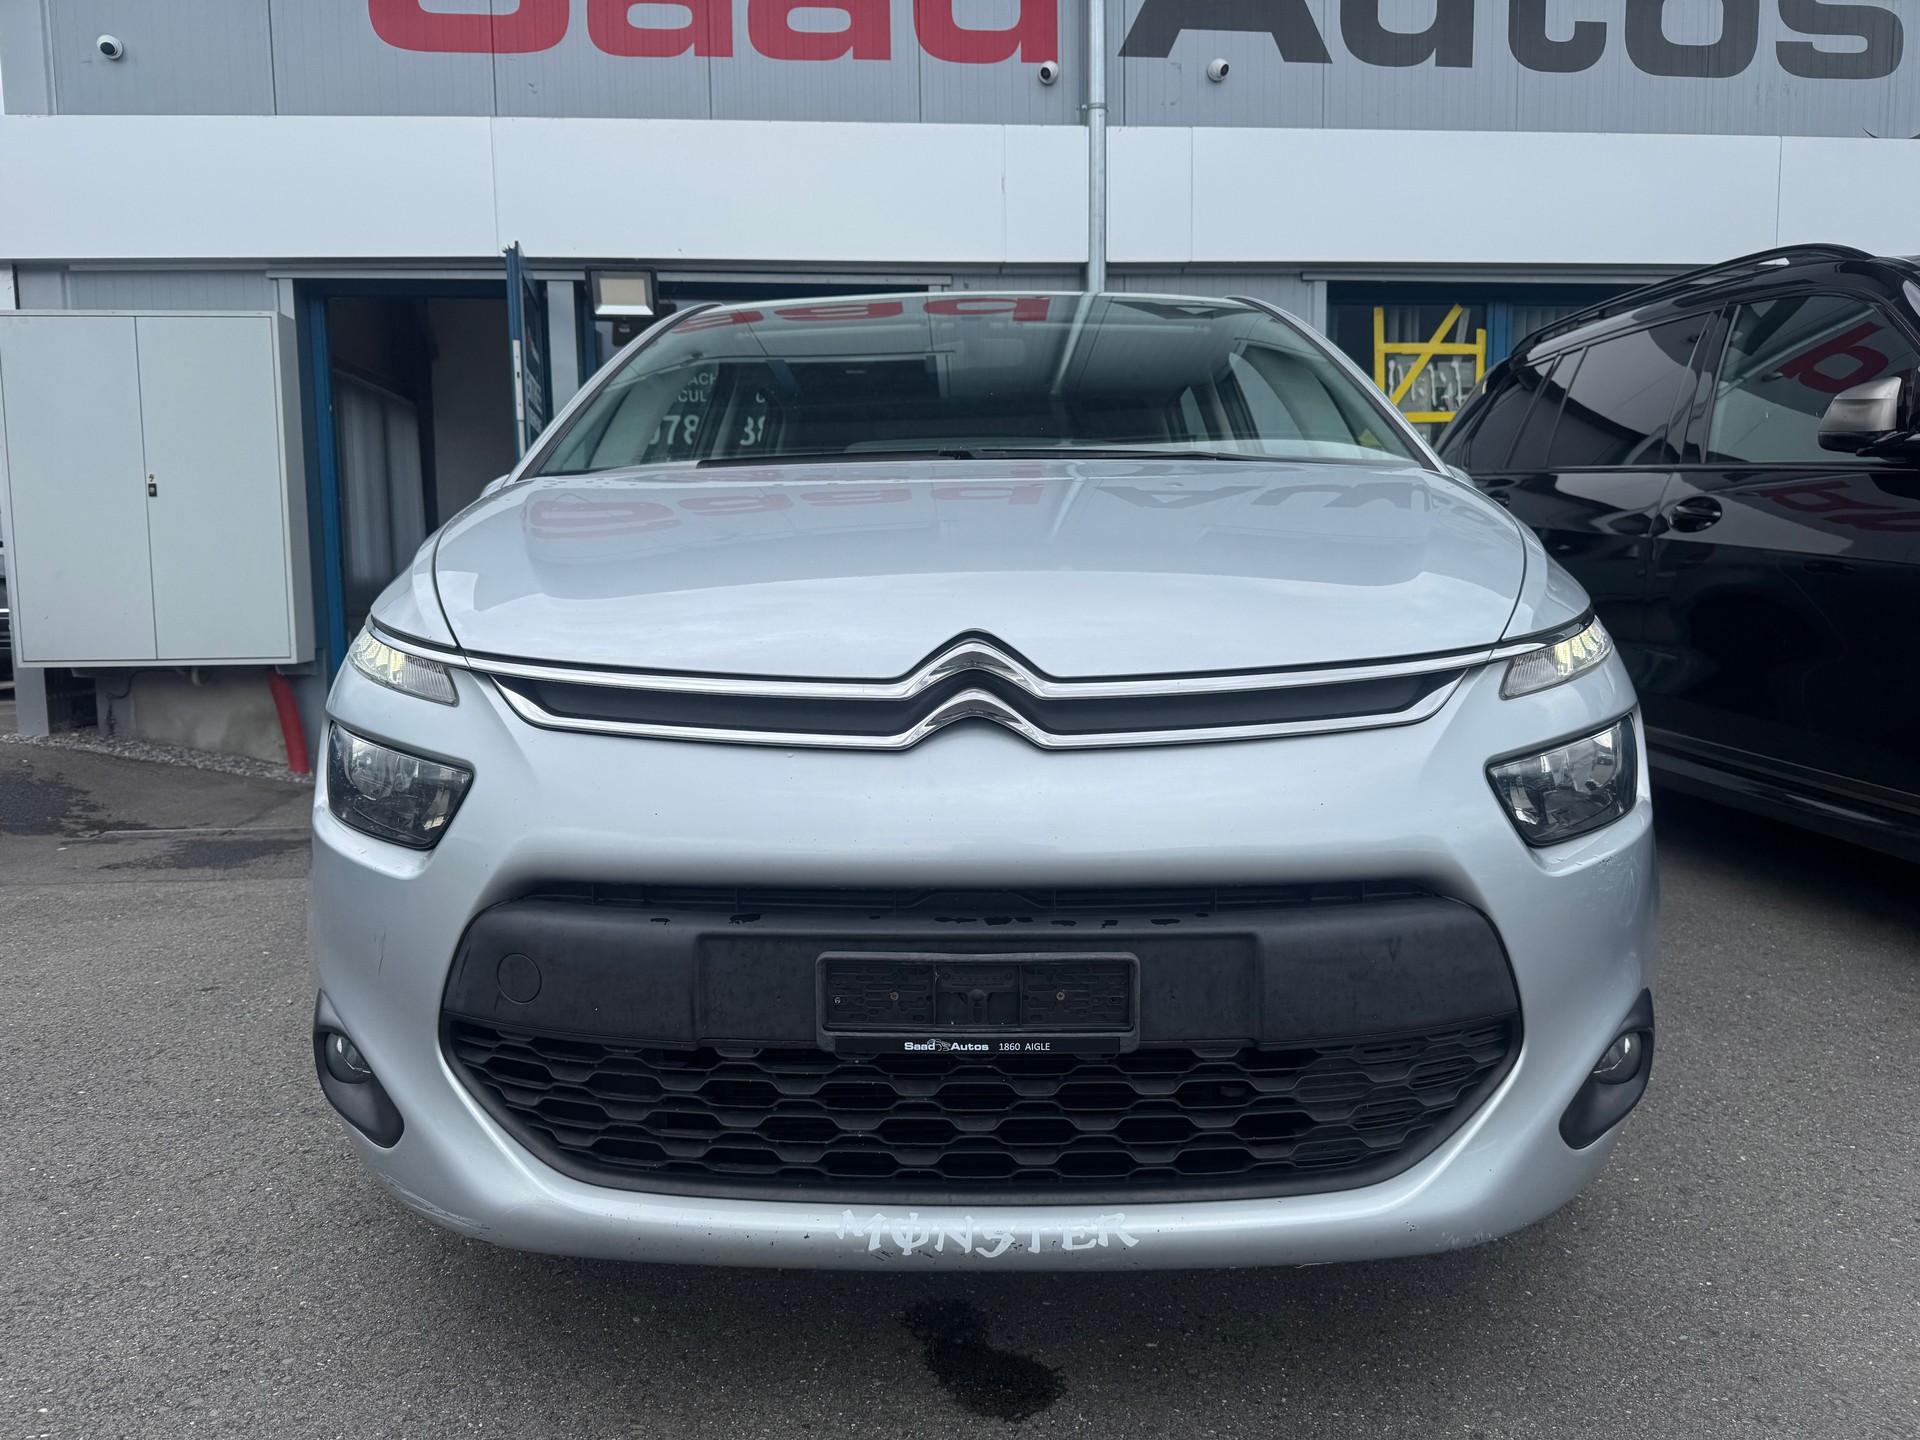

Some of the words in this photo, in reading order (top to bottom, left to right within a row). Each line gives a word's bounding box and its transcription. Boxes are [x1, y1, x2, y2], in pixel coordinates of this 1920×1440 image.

[904, 1041, 936, 1051] Saad
[950, 1042, 989, 1051] Autos
[999, 1042, 1021, 1051] 1860
[1024, 1042, 1051, 1051] AIGLE
